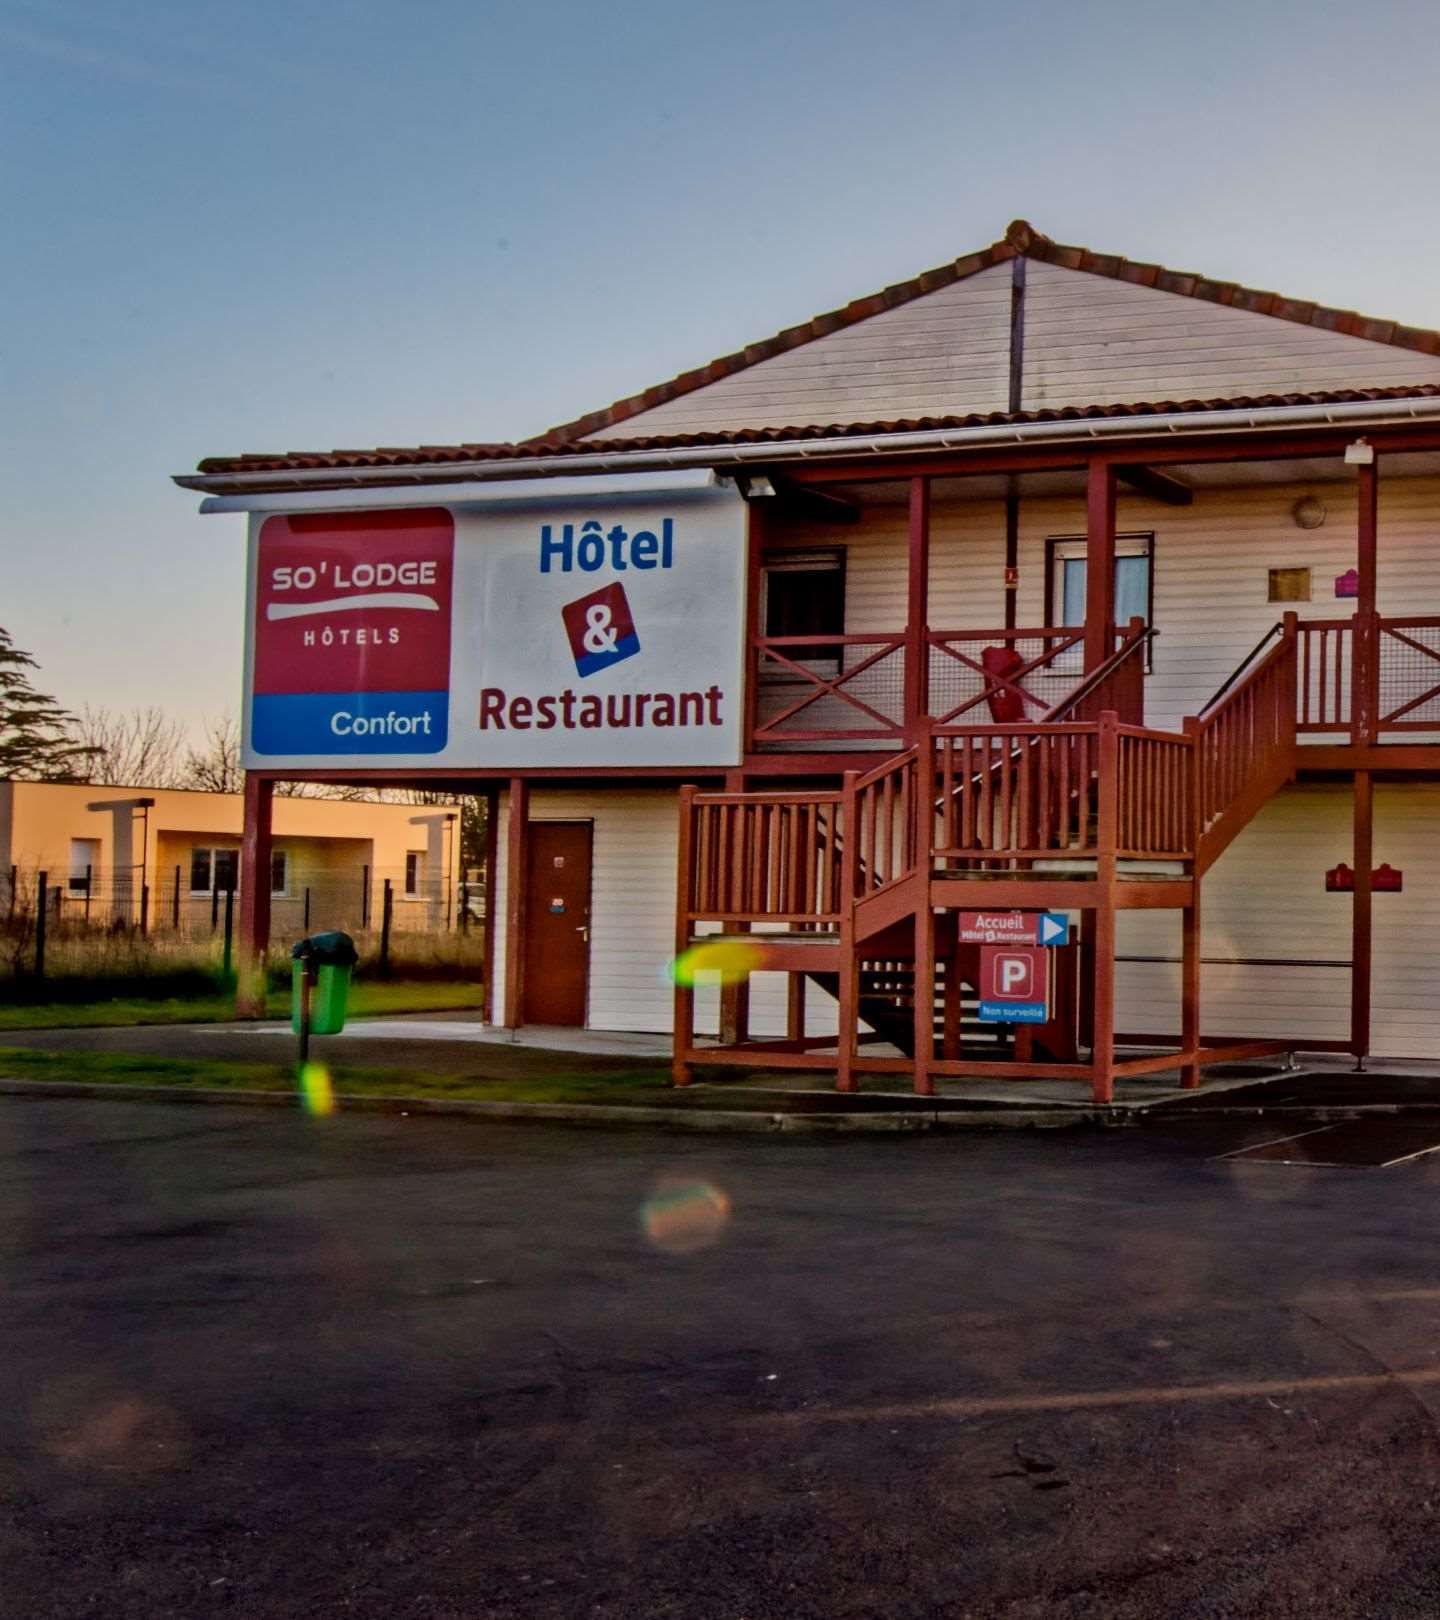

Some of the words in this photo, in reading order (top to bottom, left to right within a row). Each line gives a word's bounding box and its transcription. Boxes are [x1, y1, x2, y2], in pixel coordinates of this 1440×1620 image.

[540, 518, 674, 573] Hôtel
[304, 626, 401, 646] HÔTELS
[583, 604, 620, 653] &
[479, 685, 725, 730] Restaurant
[330, 710, 432, 735] Confort
[975, 914, 1024, 929] Accueil
[1002, 960, 1026, 992] P
[982, 1006, 1001, 1016] Non
